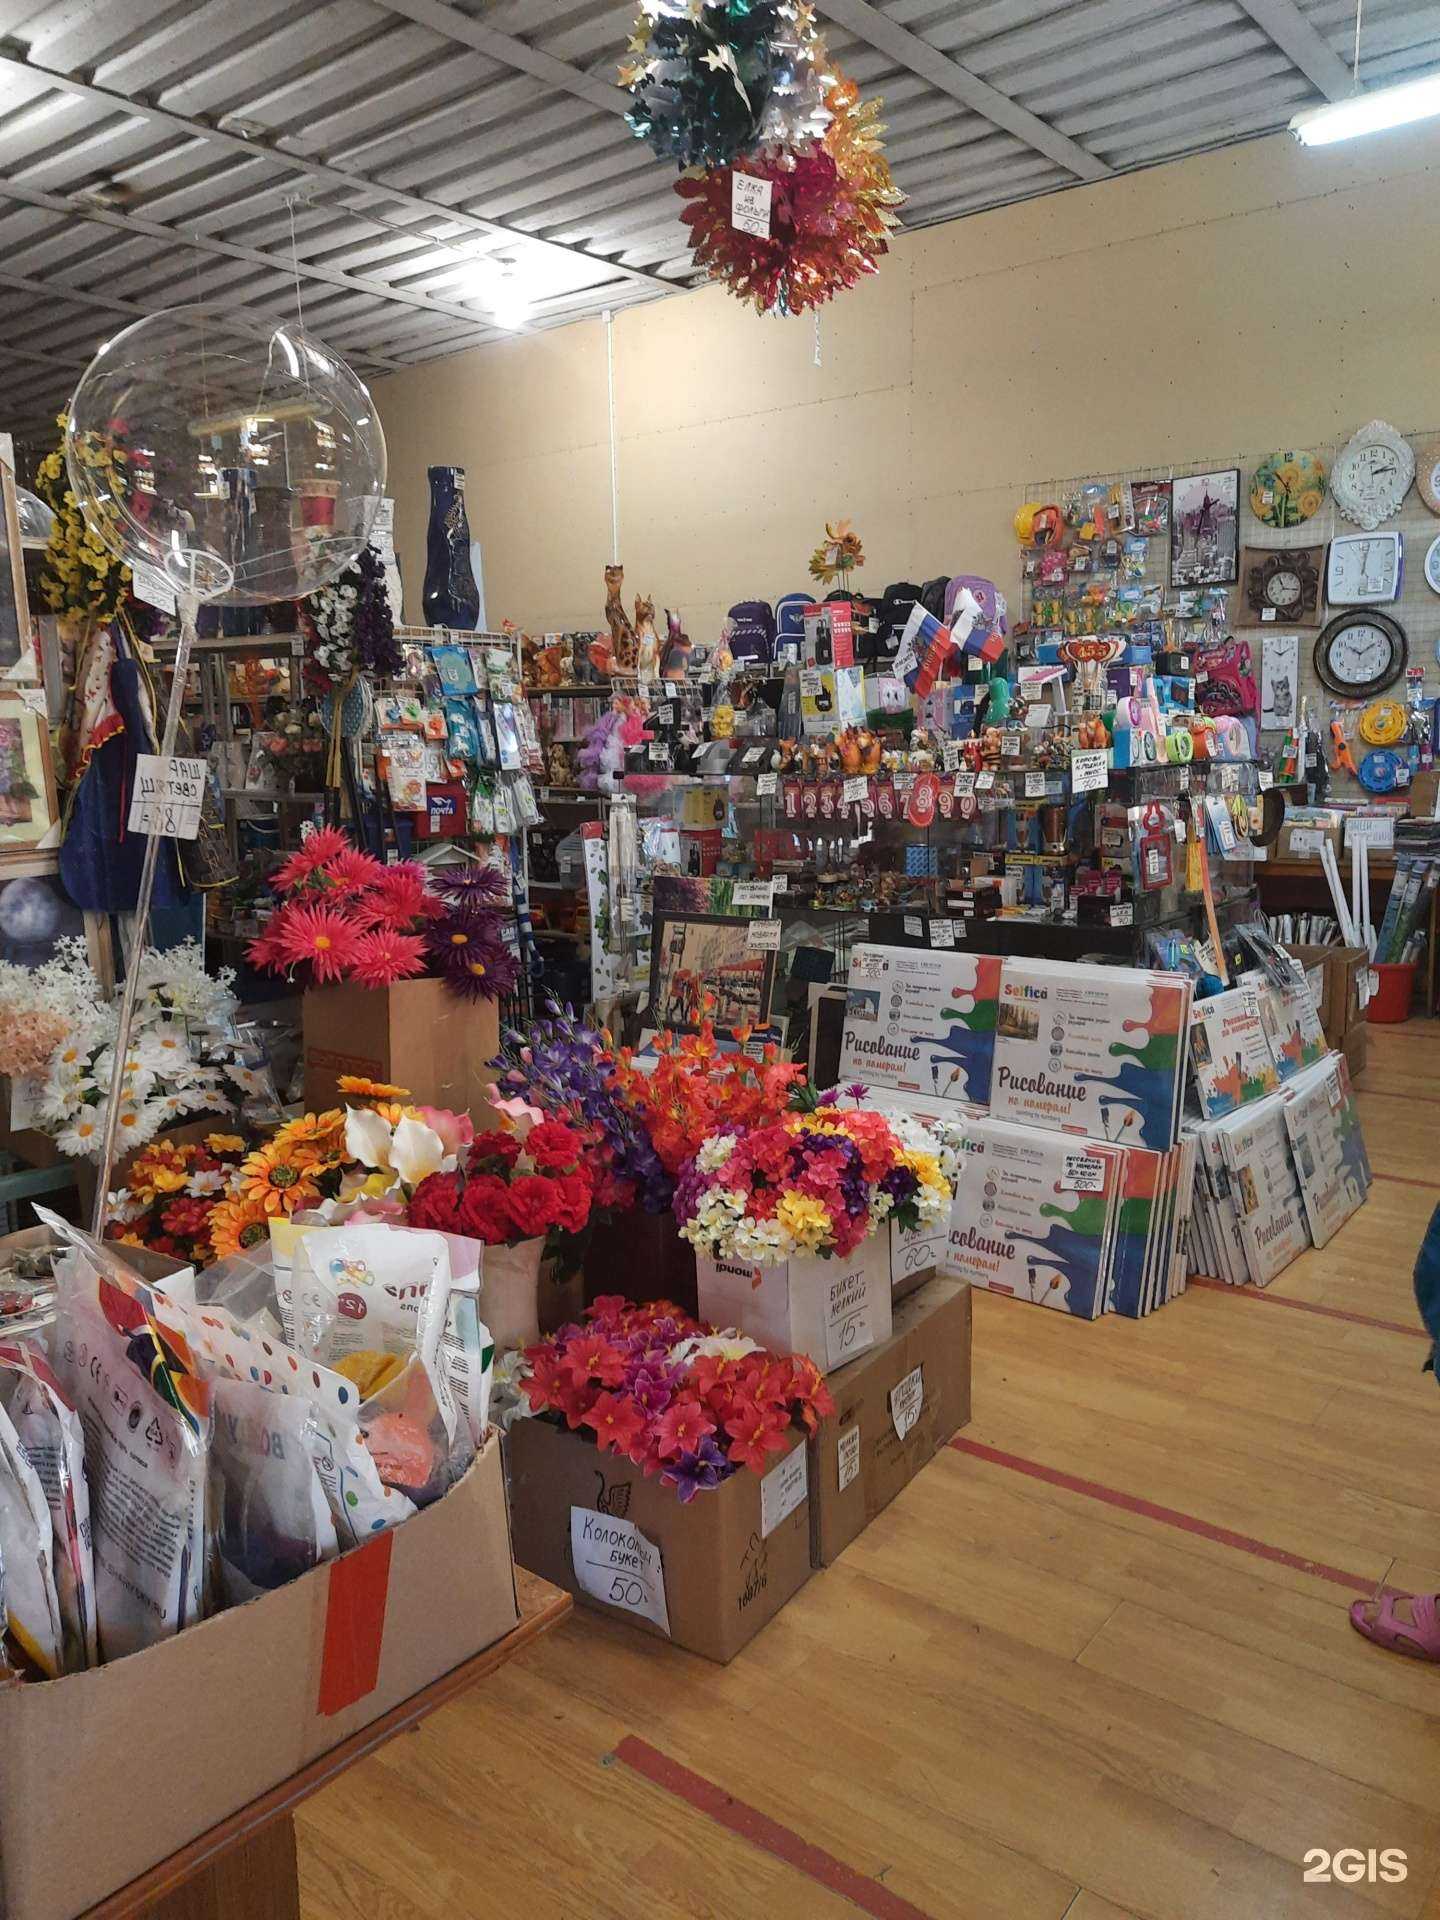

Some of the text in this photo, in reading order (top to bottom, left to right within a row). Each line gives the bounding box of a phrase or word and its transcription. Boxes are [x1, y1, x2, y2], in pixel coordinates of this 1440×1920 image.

[430, 807, 454, 816] ПОЧТА
[1004, 983, 1049, 1000] Selfica
[844, 1030, 921, 1061] Рисование
[997, 1065, 1088, 1102] Рисование
[715, 1262, 754, 1279] mondi
